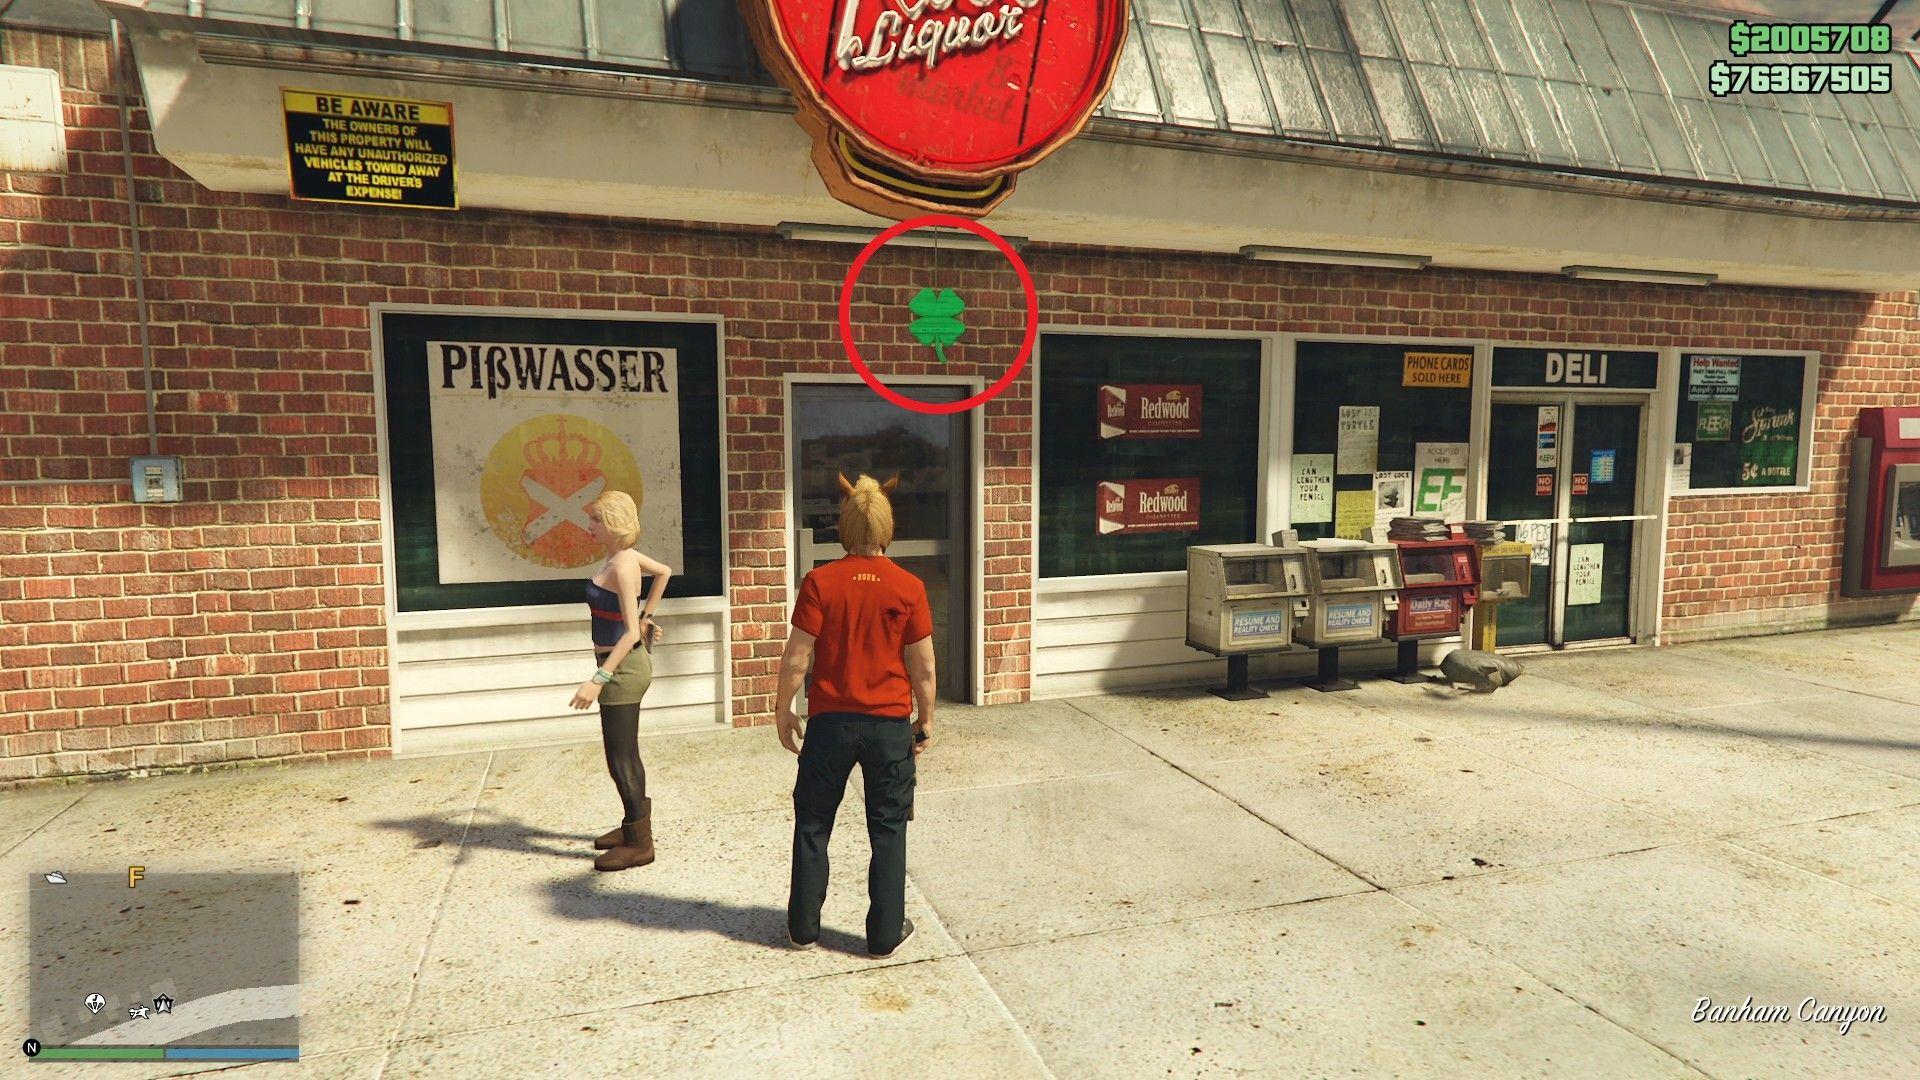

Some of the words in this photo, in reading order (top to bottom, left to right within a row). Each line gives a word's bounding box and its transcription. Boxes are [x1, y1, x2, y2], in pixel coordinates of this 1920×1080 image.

[851, 5, 1023, 70] Liquor
[316, 96, 342, 114] BE
[351, 100, 420, 121] AWARE
[322, 118, 347, 130] THE
[349, 121, 399, 135] OWNERS
[402, 125, 418, 136] OF
[310, 130, 338, 143] THIS
[341, 133, 401, 150] PROPERTY
[404, 139, 432, 151] WILL
[295, 143, 327, 155] HAVE
[330, 146, 355, 157] ANY
[357, 149, 448, 165] UNAUTHORIZED
[304, 156, 362, 172] VEHICLES
[365, 161, 406, 174] TOWED
[408, 166, 441, 177] AWAY
[328, 171, 344, 183] AT
[346, 173, 370, 185] THE
[346, 186, 402, 200] EXPENSE!
[1407, 356, 1439, 370] PHONE
[1441, 357, 1469, 371] CARDS
[1545, 352, 1608, 384] DELI
[1693, 357, 1710, 368] Help
[1712, 358, 1739, 368] Wanted
[1412, 372, 1436, 383] SOLD
[1438, 373, 1461, 384] HERE
[1691, 386, 1714, 394] Apply
[1716, 386, 1737, 394] NOW
[1141, 397, 1190, 419] Redwood
[1742, 406, 1795, 444] Sprunk
[1742, 462, 1758, 481] 5¢
[1761, 467, 1767, 476] A
[1767, 466, 1792, 477] BOTTLE
[1296, 476, 1330, 484] LENGTHEN
[1538, 476, 1551, 485] NO
[1574, 476, 1587, 485] NO
[1139, 491, 1188, 513] Redwood
[1411, 598, 1433, 611] Daily
[1434, 597, 1450, 610] Rag
[1234, 616, 1265, 626] RESUME
[1265, 615, 1280, 625] AND
[1328, 609, 1356, 619] RESUME
[1356, 608, 1372, 617] AND
[1233, 625, 1259, 634] REALITY
[1259, 624, 1280, 632] CHECK
